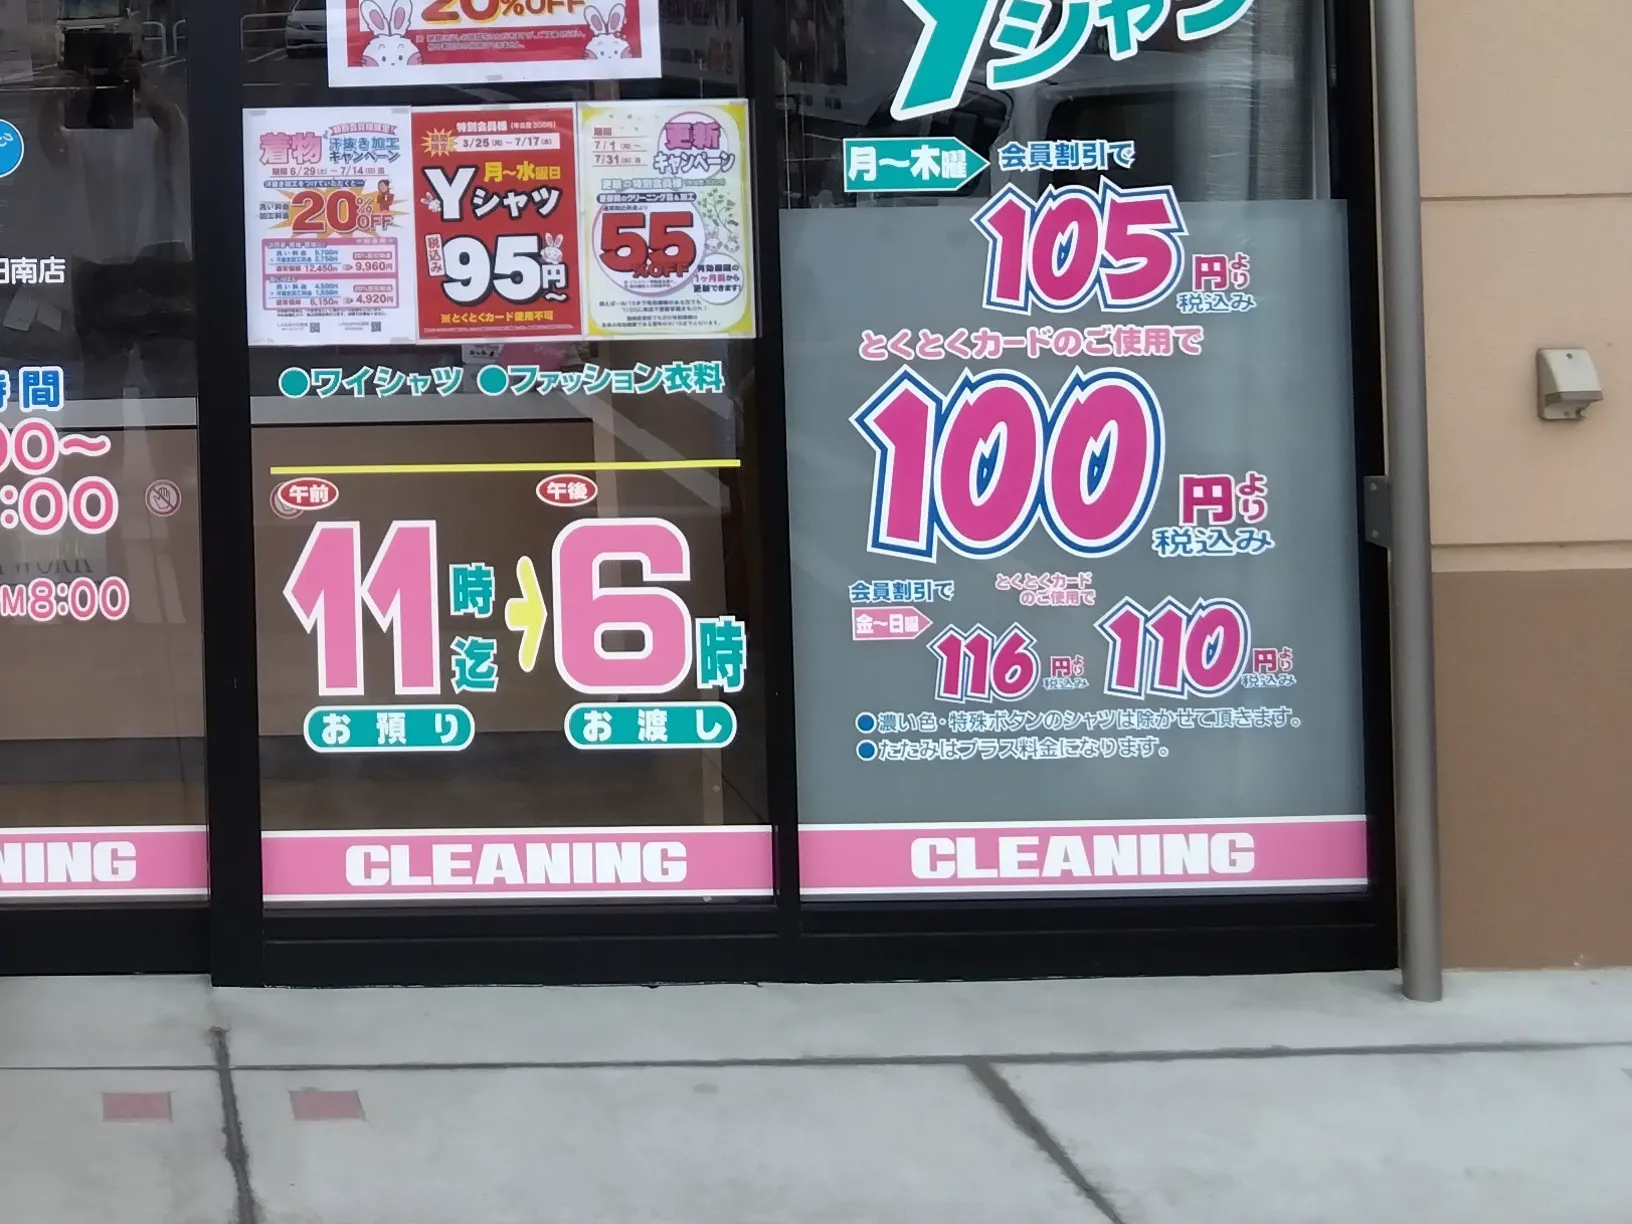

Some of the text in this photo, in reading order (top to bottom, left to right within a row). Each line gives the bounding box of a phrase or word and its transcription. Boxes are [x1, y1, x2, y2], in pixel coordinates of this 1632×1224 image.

[259, 131, 323, 165] 着物
[664, 121, 721, 152] 更新
[329, 151, 401, 164] キャンペーン
[653, 152, 735, 174] キャンペーン
[998, 141, 1135, 171] 会員割引で
[600, 211, 696, 273] 55
[970, 175, 1189, 315] 105
[442, 235, 542, 304] 95
[1177, 293, 1256, 313] 税込み
[859, 325, 1204, 360] とくとくカードのご使用で
[310, 362, 725, 399] ワイシャツ ファッション衣料
[849, 364, 1166, 563] 100
[289, 484, 330, 504] 午前
[546, 481, 588, 501] 午後
[1152, 527, 1274, 558] 税込み
[849, 580, 955, 603] 会員割引で
[995, 572, 1093, 592] とくとくカード
[1019, 588, 1096, 607] のご使用で
[283, 520, 441, 696] 11
[552, 517, 746, 694] 6 時
[927, 622, 1041, 703] 116
[1094, 595, 1251, 700] 110
[1043, 677, 1089, 691] 税込み
[1241, 673, 1296, 688] 税込み
[321, 712, 459, 745] お預り
[582, 709, 722, 743] お渡し
[345, 840, 687, 886] CLEANING
[911, 832, 1255, 879] CLEANING
